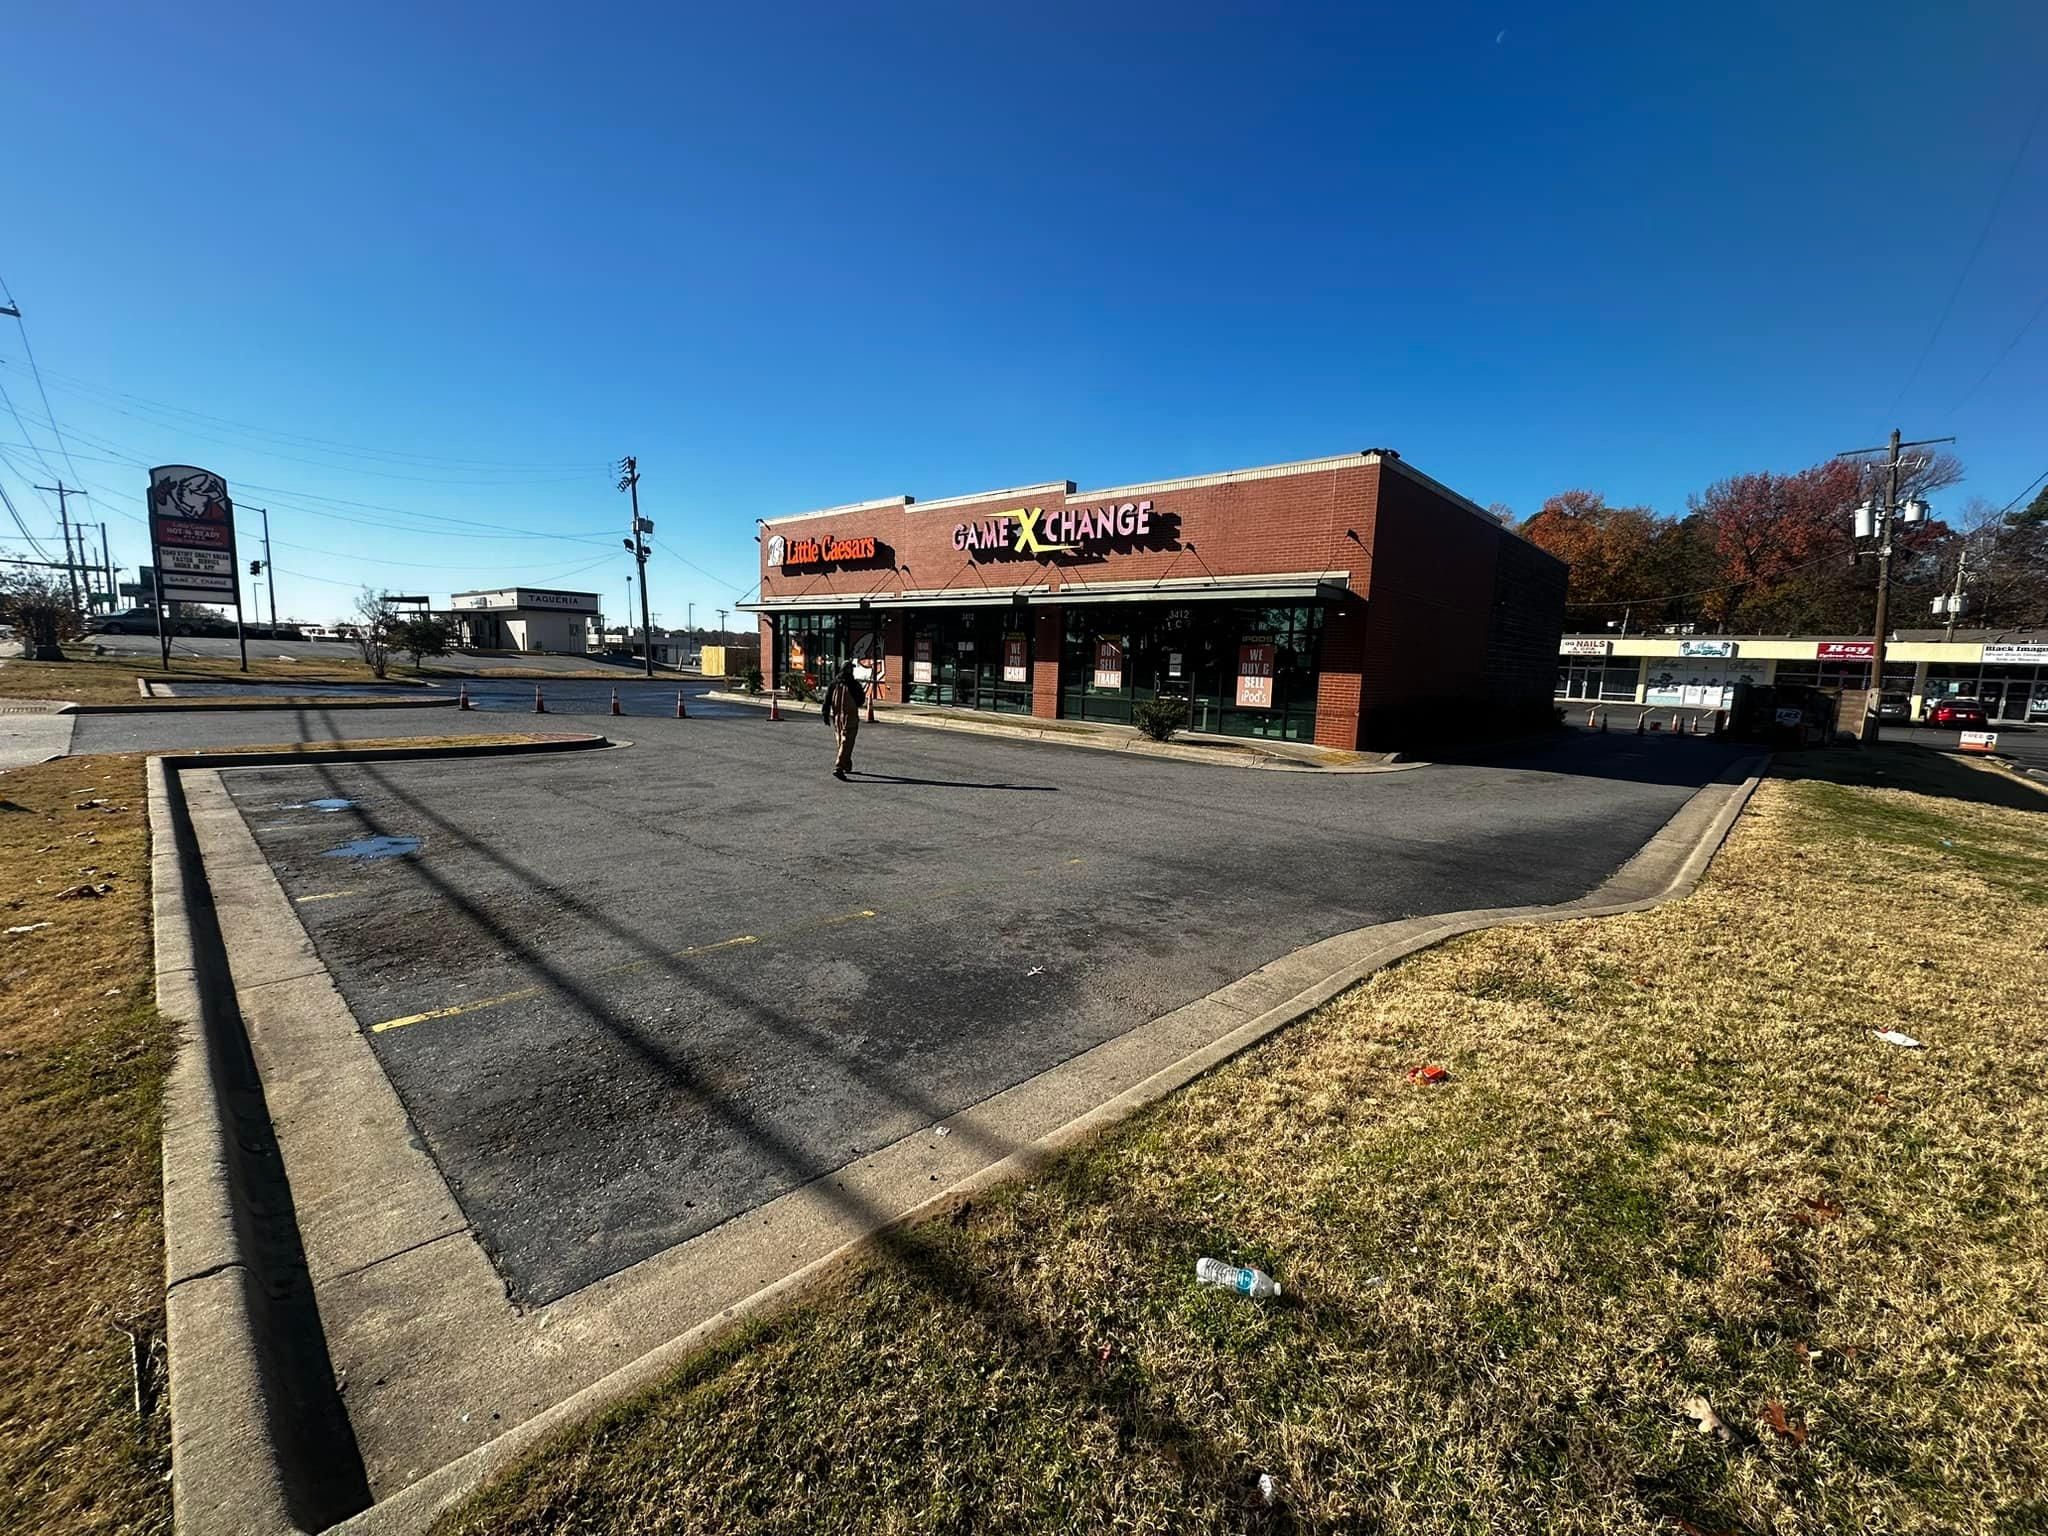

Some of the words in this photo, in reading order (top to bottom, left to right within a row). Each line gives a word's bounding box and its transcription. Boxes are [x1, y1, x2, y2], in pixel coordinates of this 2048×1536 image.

[952, 518, 1010, 551] GAME
[1045, 500, 1152, 543] CHANGE
[785, 538, 819, 565] Little
[821, 534, 875, 562] Caesars
[527, 594, 579, 605] TAQUERIA
[1576, 640, 1606, 648] NAILS
[1825, 644, 1872, 655] Ray
[1249, 648, 1263, 661] WE
[1099, 658, 1116, 670] SELL
[1241, 662, 1260, 675] BUY
[1096, 671, 1120, 686] TRADE
[1244, 676, 1265, 689] SELL
